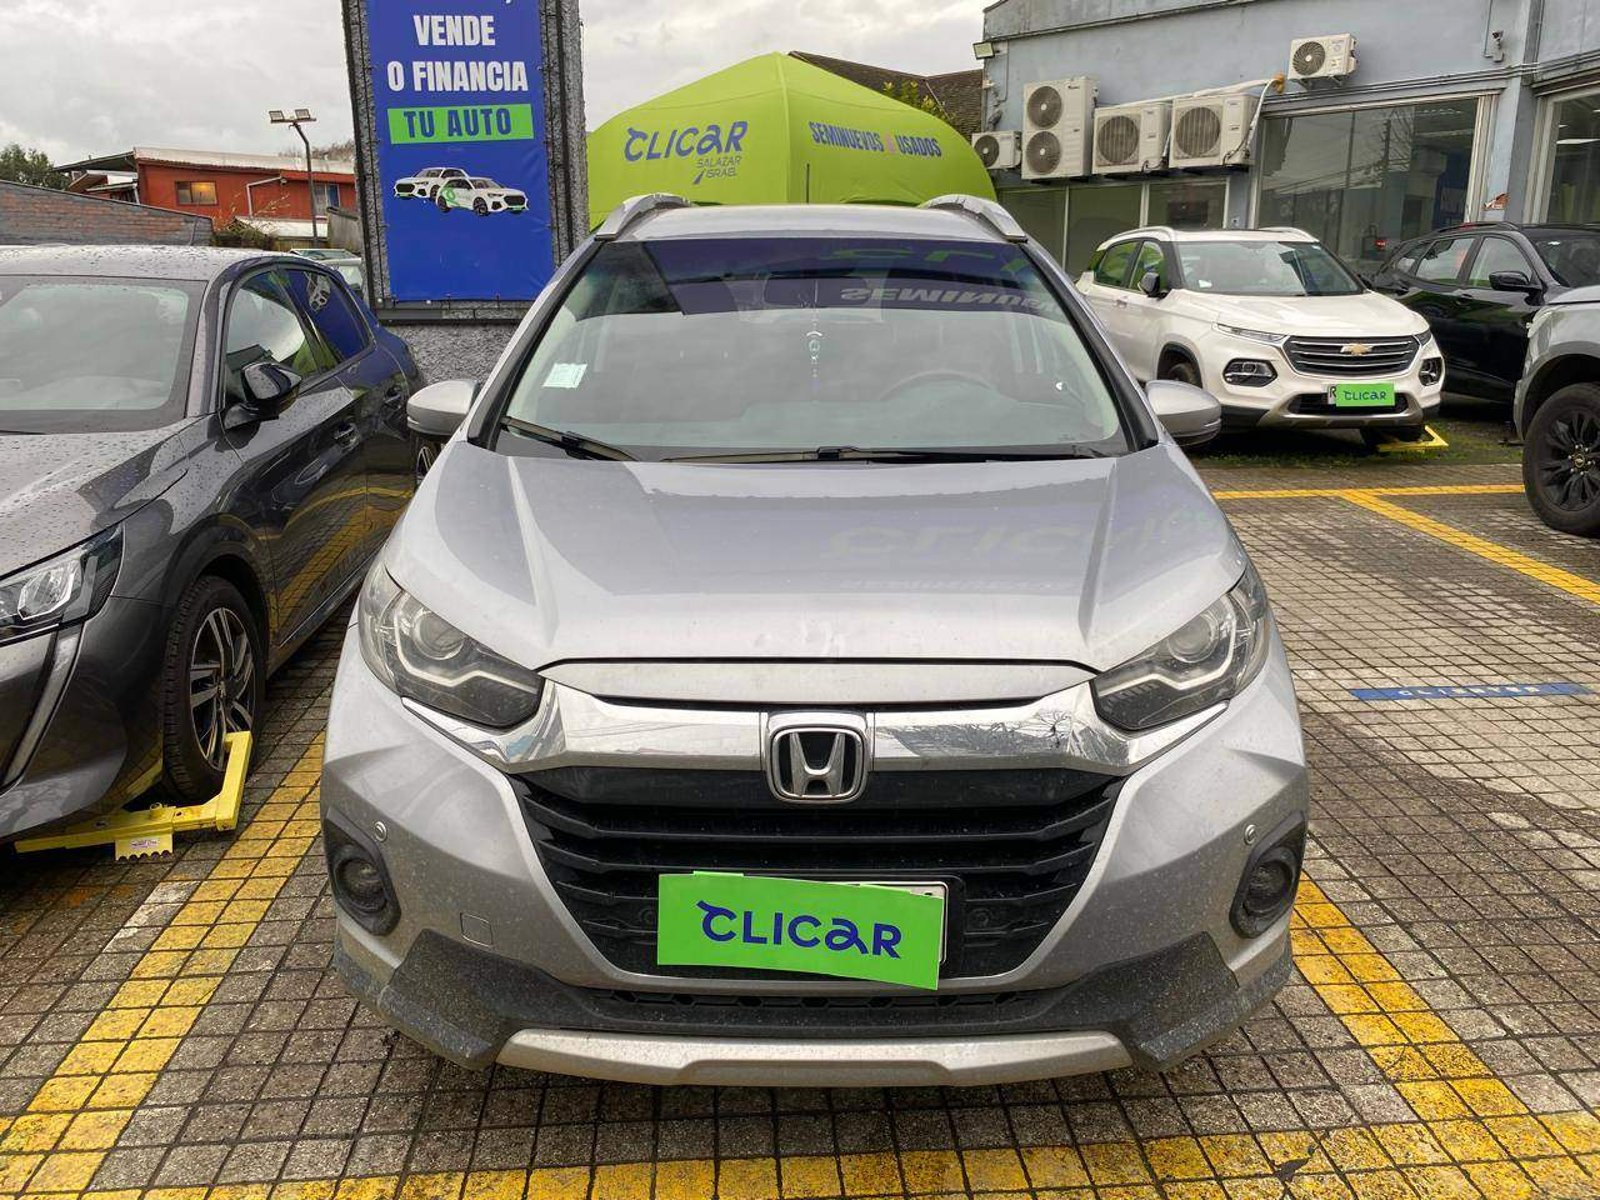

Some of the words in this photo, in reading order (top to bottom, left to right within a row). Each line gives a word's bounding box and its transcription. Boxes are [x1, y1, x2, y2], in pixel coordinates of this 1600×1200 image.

[413, 15, 496, 46] VENDE
[387, 61, 405, 92] O
[412, 61, 528, 92] FINANCIA
[403, 111, 434, 138] TU
[447, 109, 512, 137] AUTO
[808, 121, 884, 152] SEMINUEVOS
[895, 134, 942, 157] USADOS
[696, 156, 742, 168] SALAZAR
